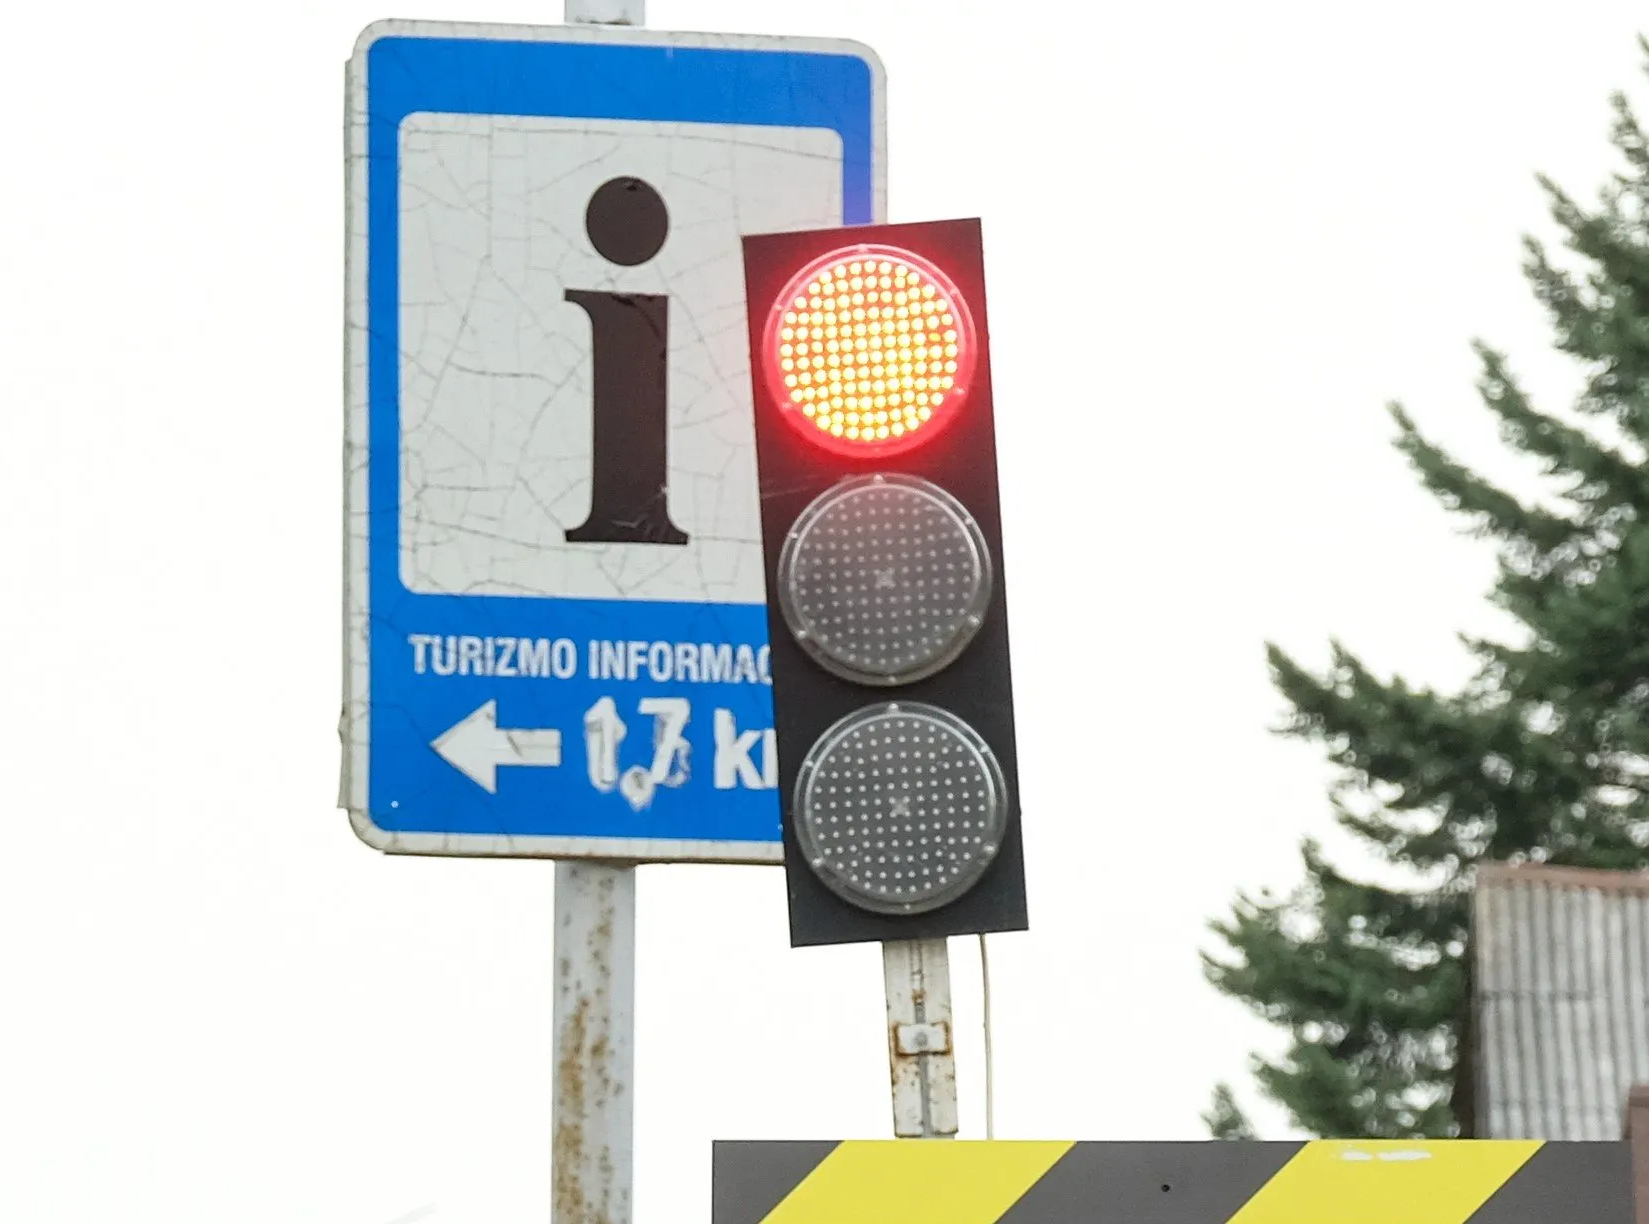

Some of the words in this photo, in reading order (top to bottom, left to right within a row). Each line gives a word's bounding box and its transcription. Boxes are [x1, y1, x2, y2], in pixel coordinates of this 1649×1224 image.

[563, 174, 690, 545] i
[407, 633, 578, 680] TURIZMO
[588, 639, 774, 685] INFORMAC
[713, 707, 778, 789] k
